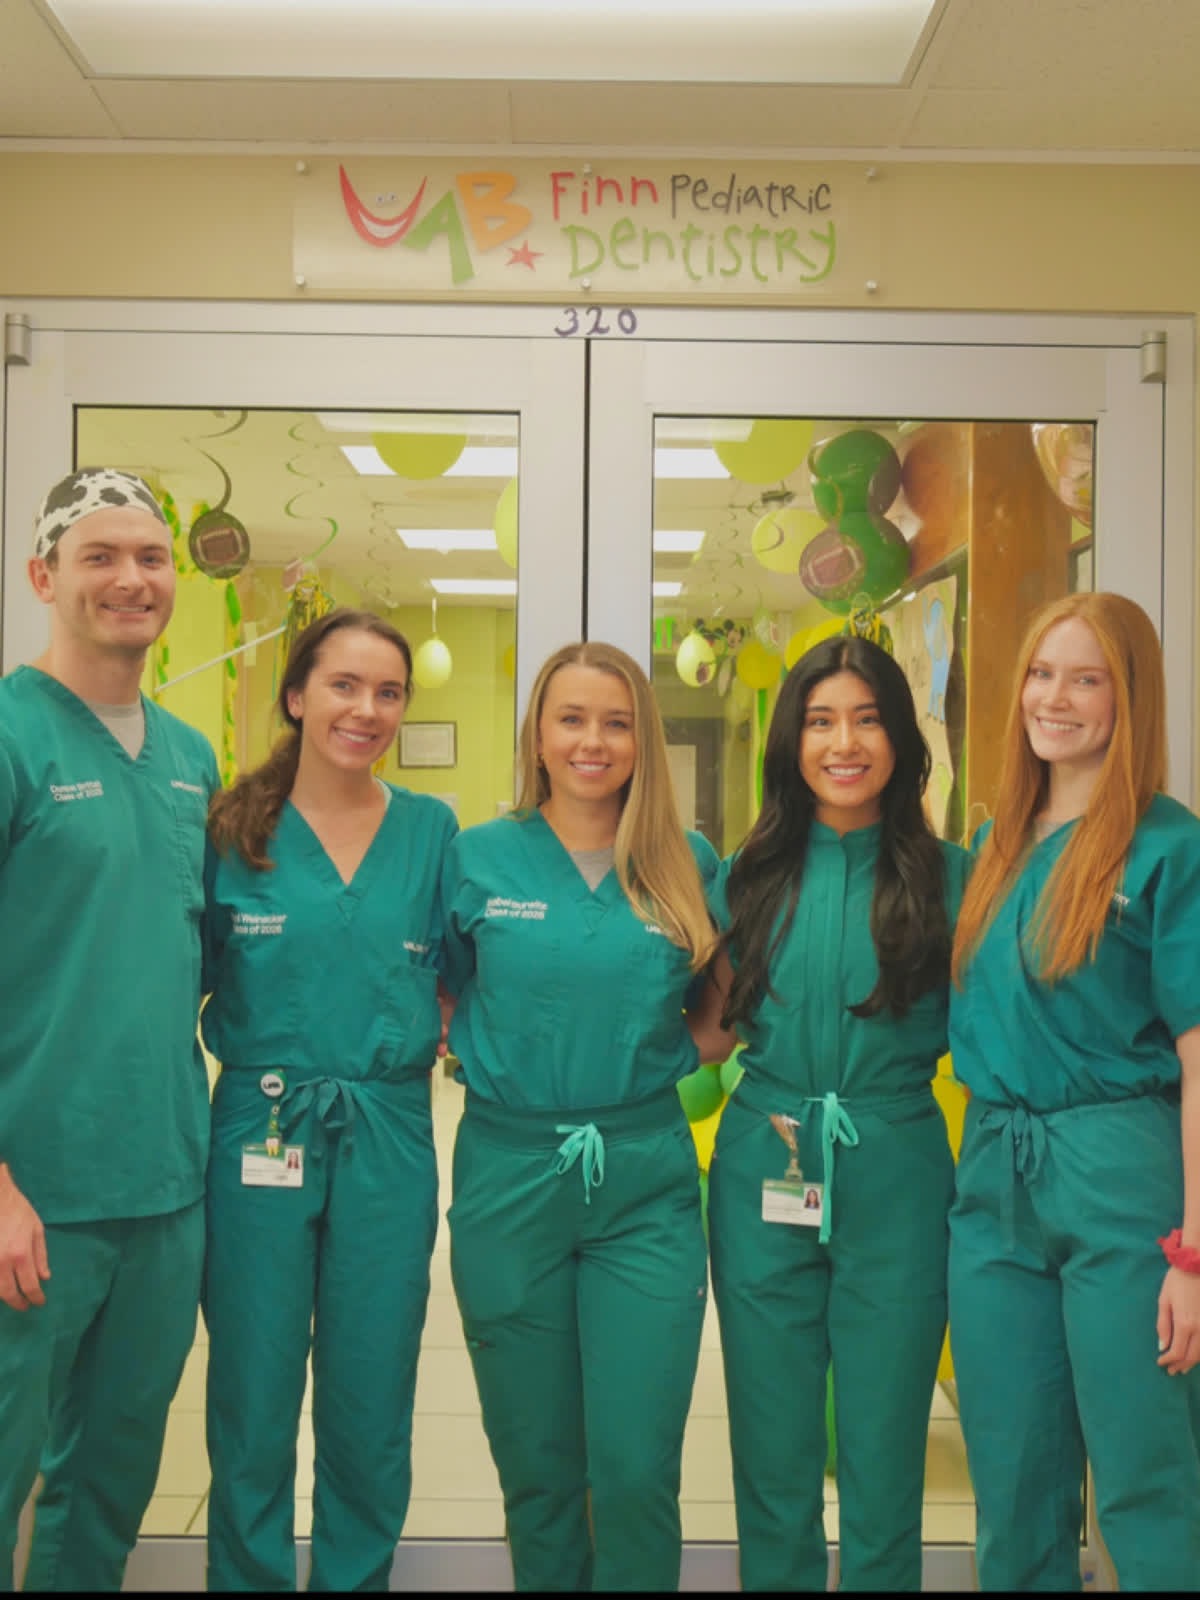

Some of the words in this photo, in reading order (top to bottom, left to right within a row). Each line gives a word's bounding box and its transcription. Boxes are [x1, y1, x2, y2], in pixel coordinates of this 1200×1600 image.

[549, 171, 658, 220] Finn
[338, 163, 534, 285] UAB
[555, 307, 638, 338] 320
